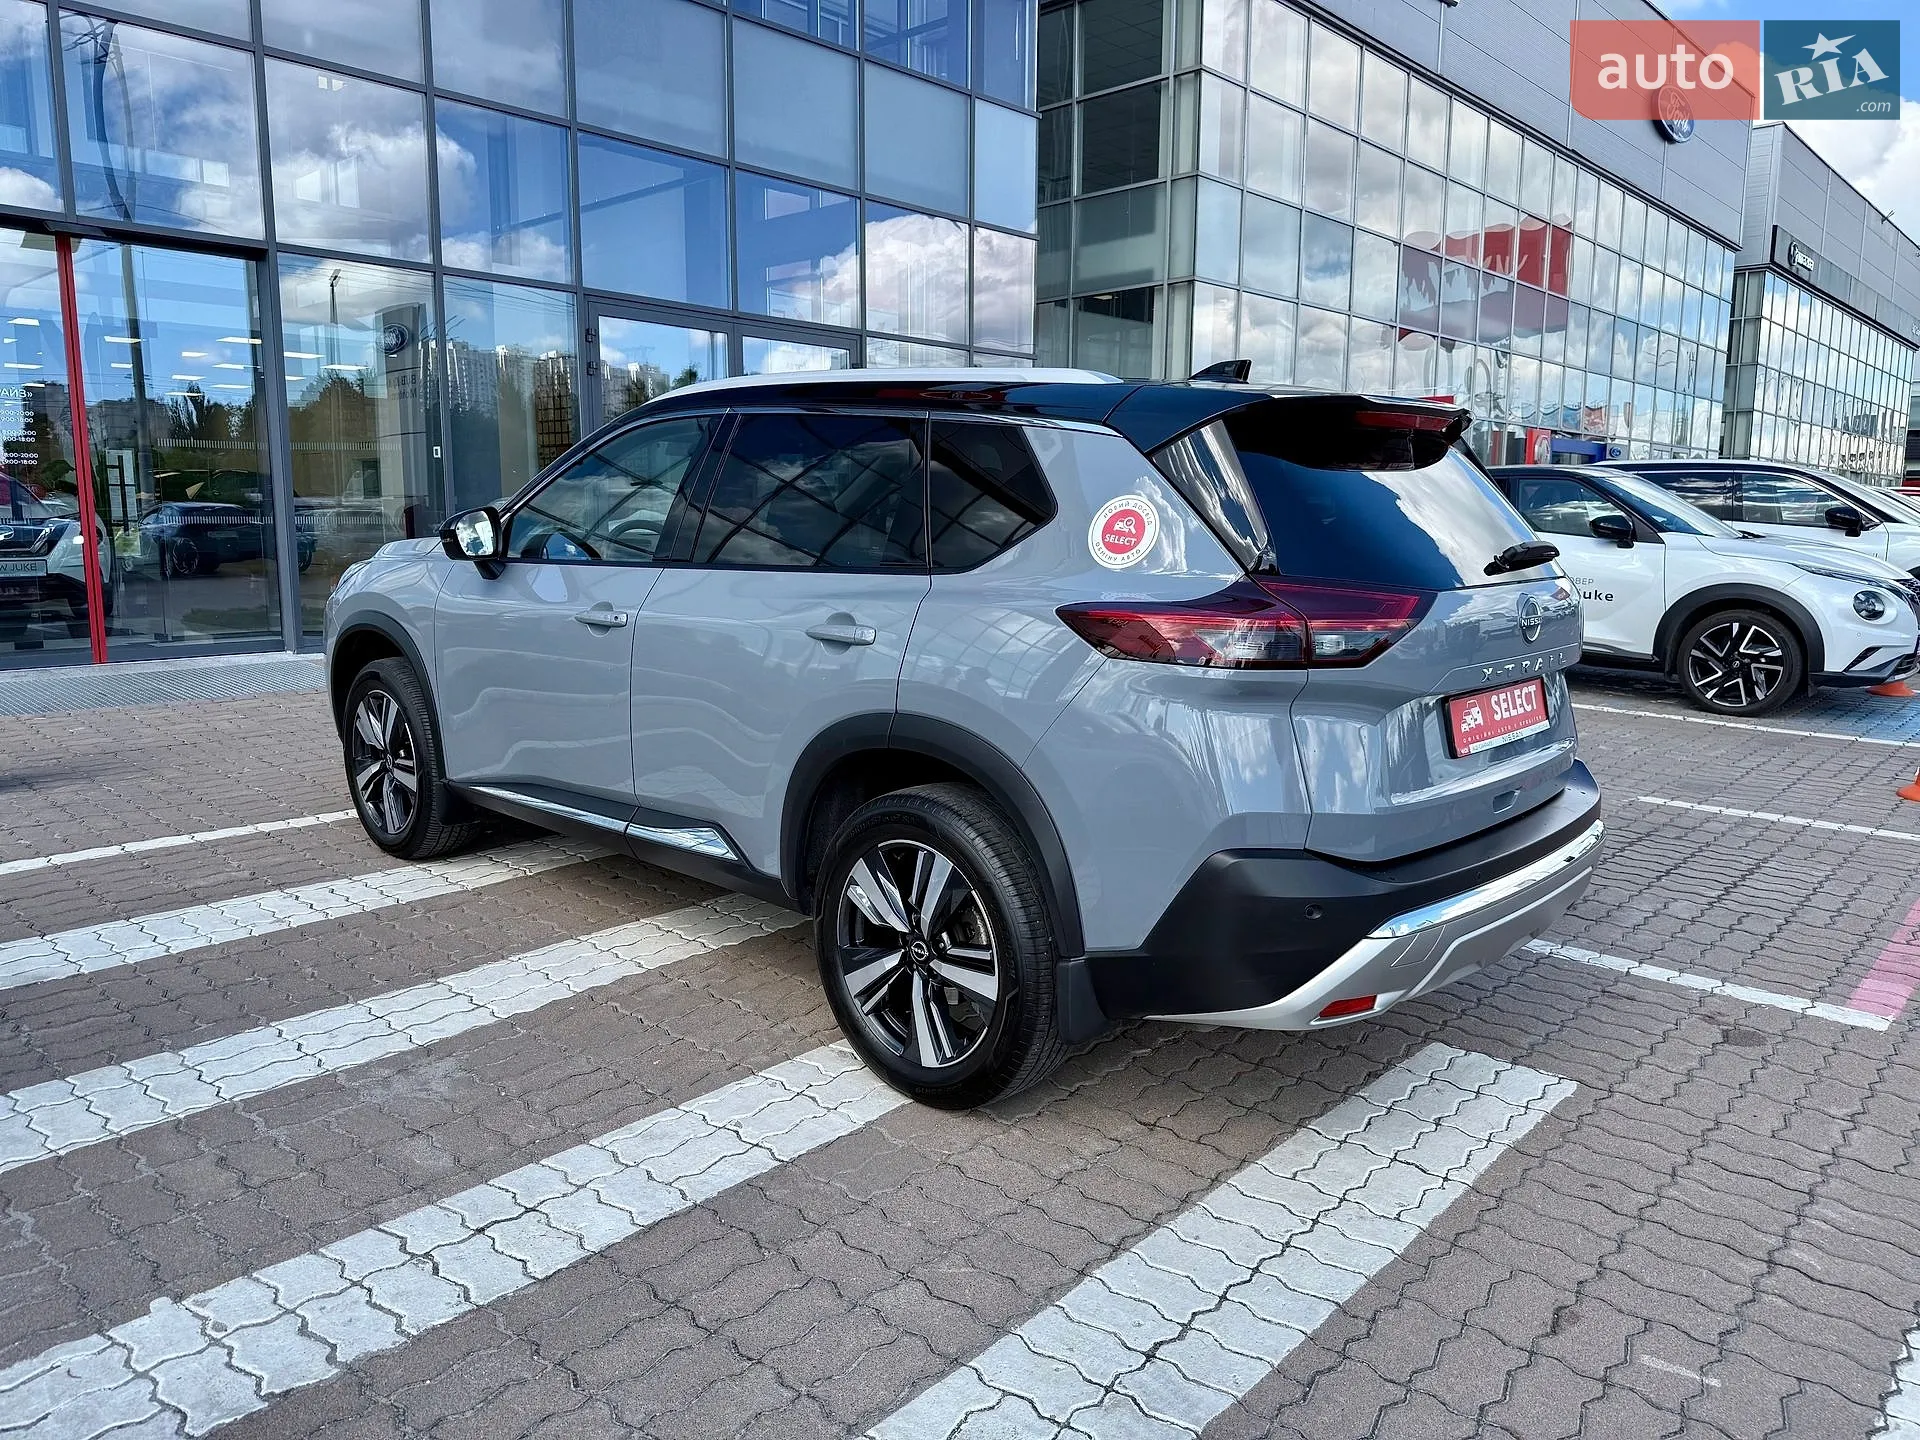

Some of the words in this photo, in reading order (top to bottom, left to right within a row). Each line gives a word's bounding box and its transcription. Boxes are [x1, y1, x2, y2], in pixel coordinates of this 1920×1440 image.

[0, 386, 33, 398] АЙЗ»
[1104, 533, 1137, 547] SELECT
[11, 563, 37, 571] JUKE
[1579, 588, 1614, 602] uke
[1490, 684, 1537, 721] SELECT
